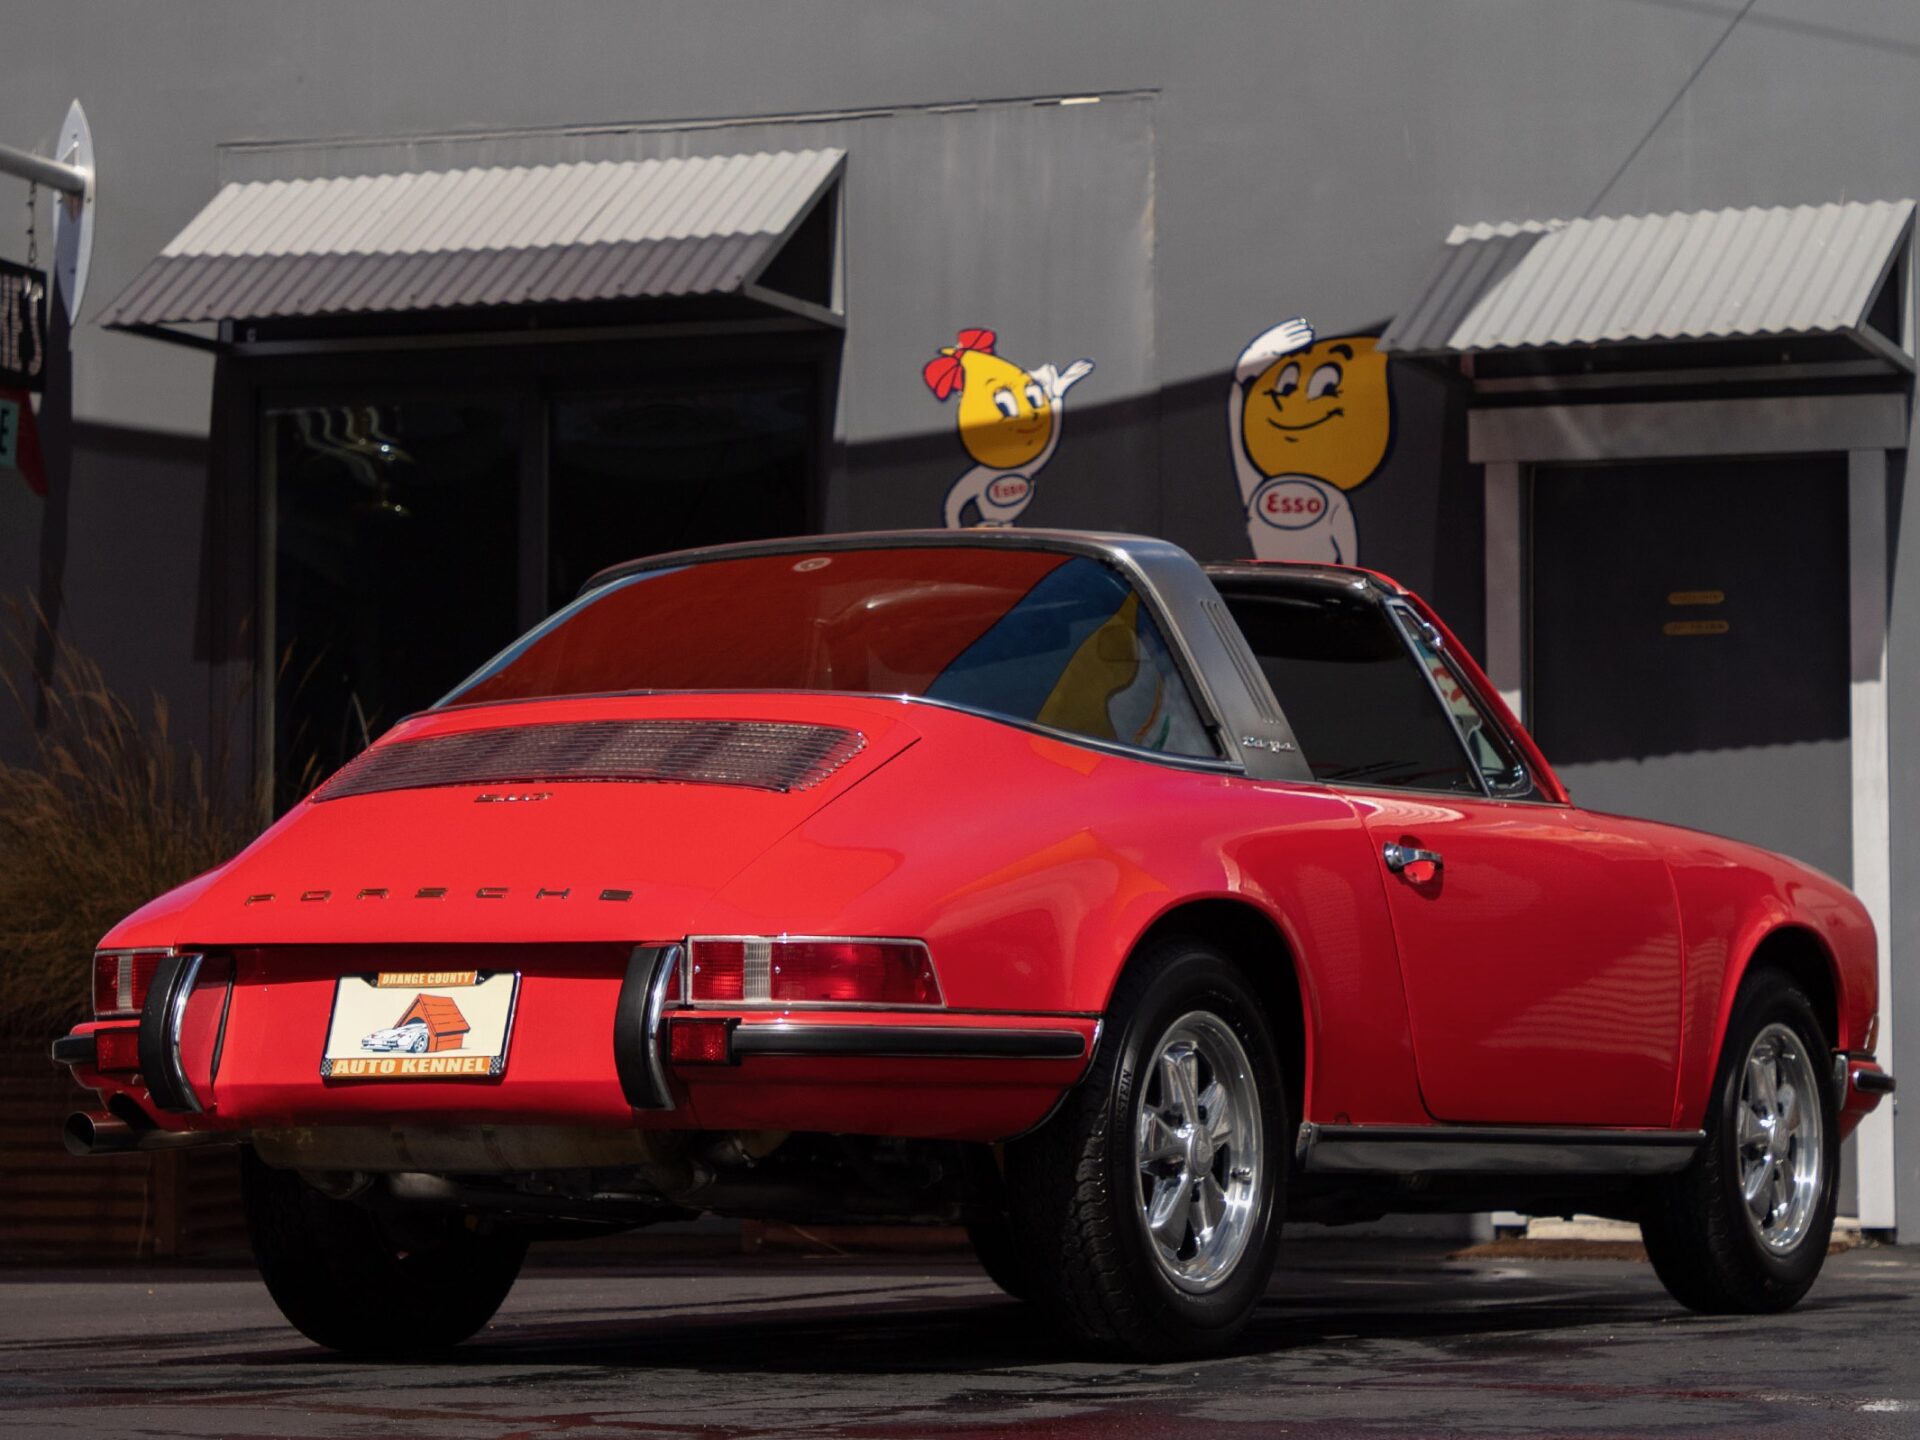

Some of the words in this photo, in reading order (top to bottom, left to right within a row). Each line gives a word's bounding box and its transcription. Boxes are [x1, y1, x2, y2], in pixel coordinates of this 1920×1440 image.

[1266, 492, 1321, 513] Esso
[244, 886, 634, 906] PORSCHE
[382, 973, 424, 985] ORANGE
[427, 972, 471, 984] COUNTY
[333, 1058, 396, 1075] AUTO
[401, 1057, 487, 1074] KENNEL
